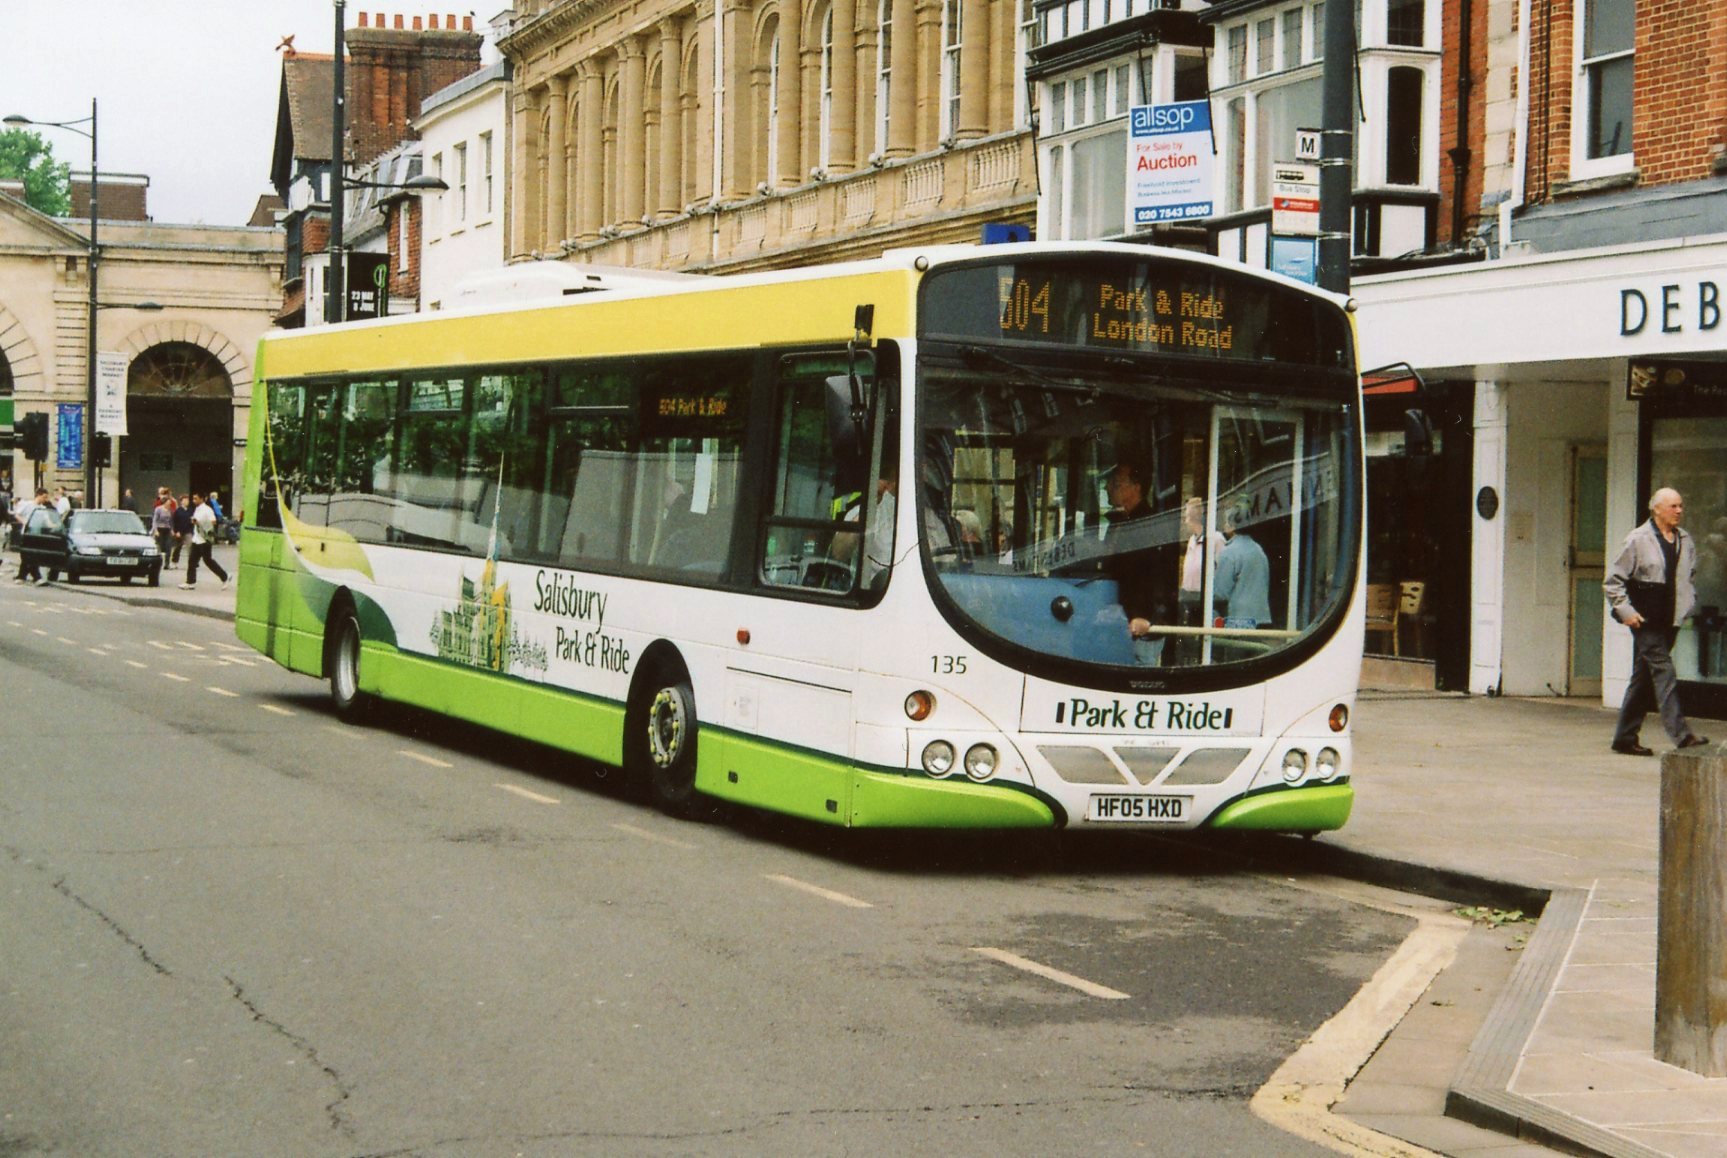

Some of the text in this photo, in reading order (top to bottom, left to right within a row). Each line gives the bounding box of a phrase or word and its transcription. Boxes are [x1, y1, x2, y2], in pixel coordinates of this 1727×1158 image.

[1135, 105, 1194, 130] allsop
[1136, 142, 1183, 152] For Sale by
[1301, 137, 1315, 153] M
[1137, 153, 1197, 171] Auction
[1138, 209, 1157, 220] 020
[1159, 207, 1183, 218] 7543
[999, 277, 1050, 333] 504
[1100, 283, 1224, 320] Park & Ride
[1620, 281, 1720, 336] DEB
[1093, 312, 1233, 349] London Road
[534, 569, 608, 634] Salisbury
[556, 626, 630, 674] Park & Ride
[931, 655, 967, 675] 135
[1070, 698, 1224, 730] Park & Ride
[1098, 799, 1182, 819] HF05 HXD
